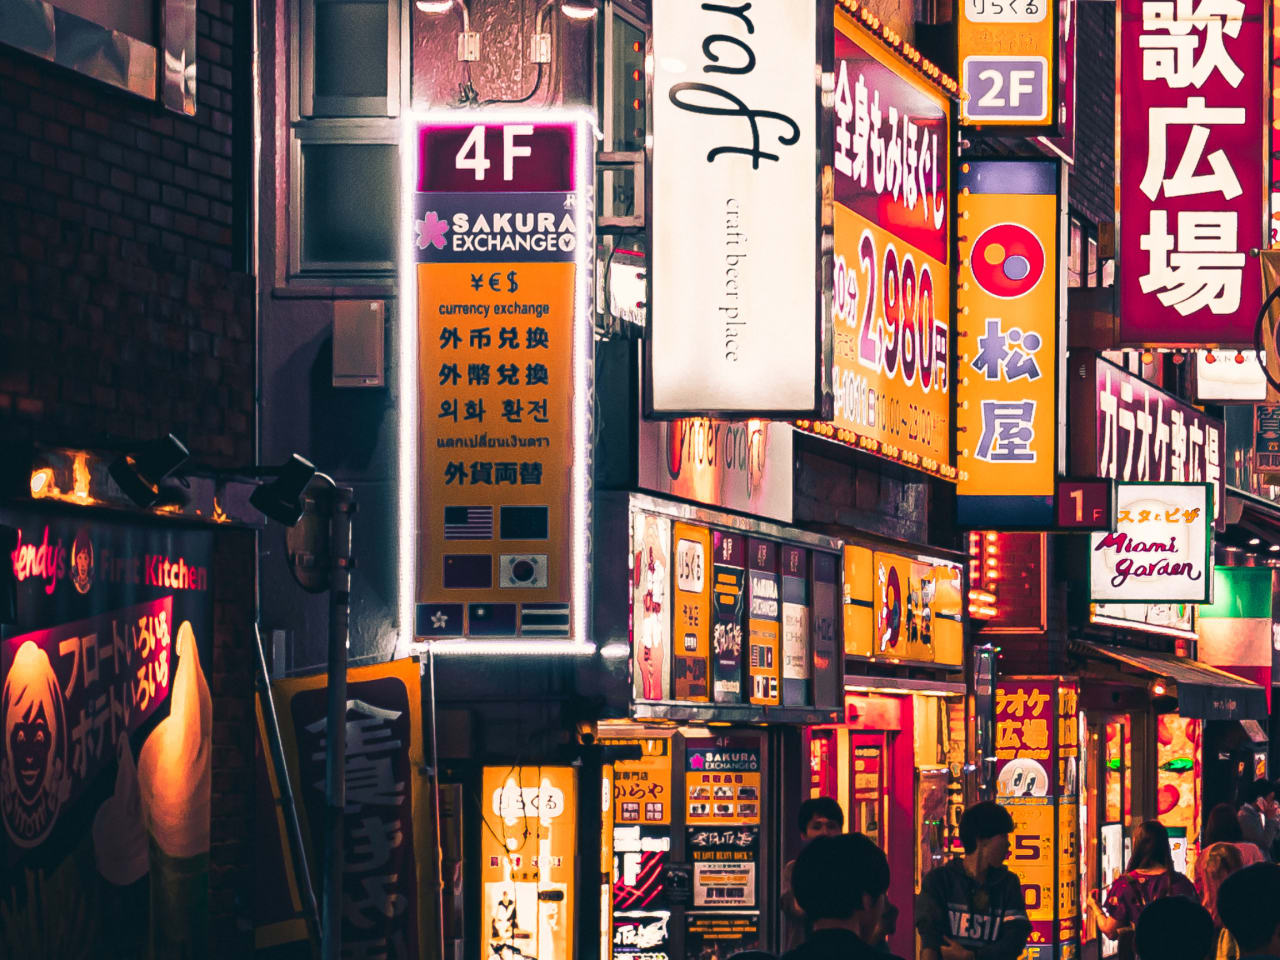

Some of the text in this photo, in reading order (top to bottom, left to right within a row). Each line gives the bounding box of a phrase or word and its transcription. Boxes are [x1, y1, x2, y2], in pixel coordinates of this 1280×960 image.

[977, 69, 1035, 107] 2F
[455, 123, 534, 181] 4F
[835, 58, 945, 230] 全身もみほぐし
[452, 212, 576, 234] SAKURA
[452, 234, 558, 252] EXCHANGE
[726, 252, 748, 301] beer
[438, 302, 550, 319] currency exchange
[718, 305, 748, 363] place
[971, 318, 1043, 464] 松屋
[437, 397, 550, 423] 외화 환전
[444, 462, 543, 486] 外貨両替
[1095, 532, 1179, 554] Miami
[145, 554, 208, 591] Kitchen
